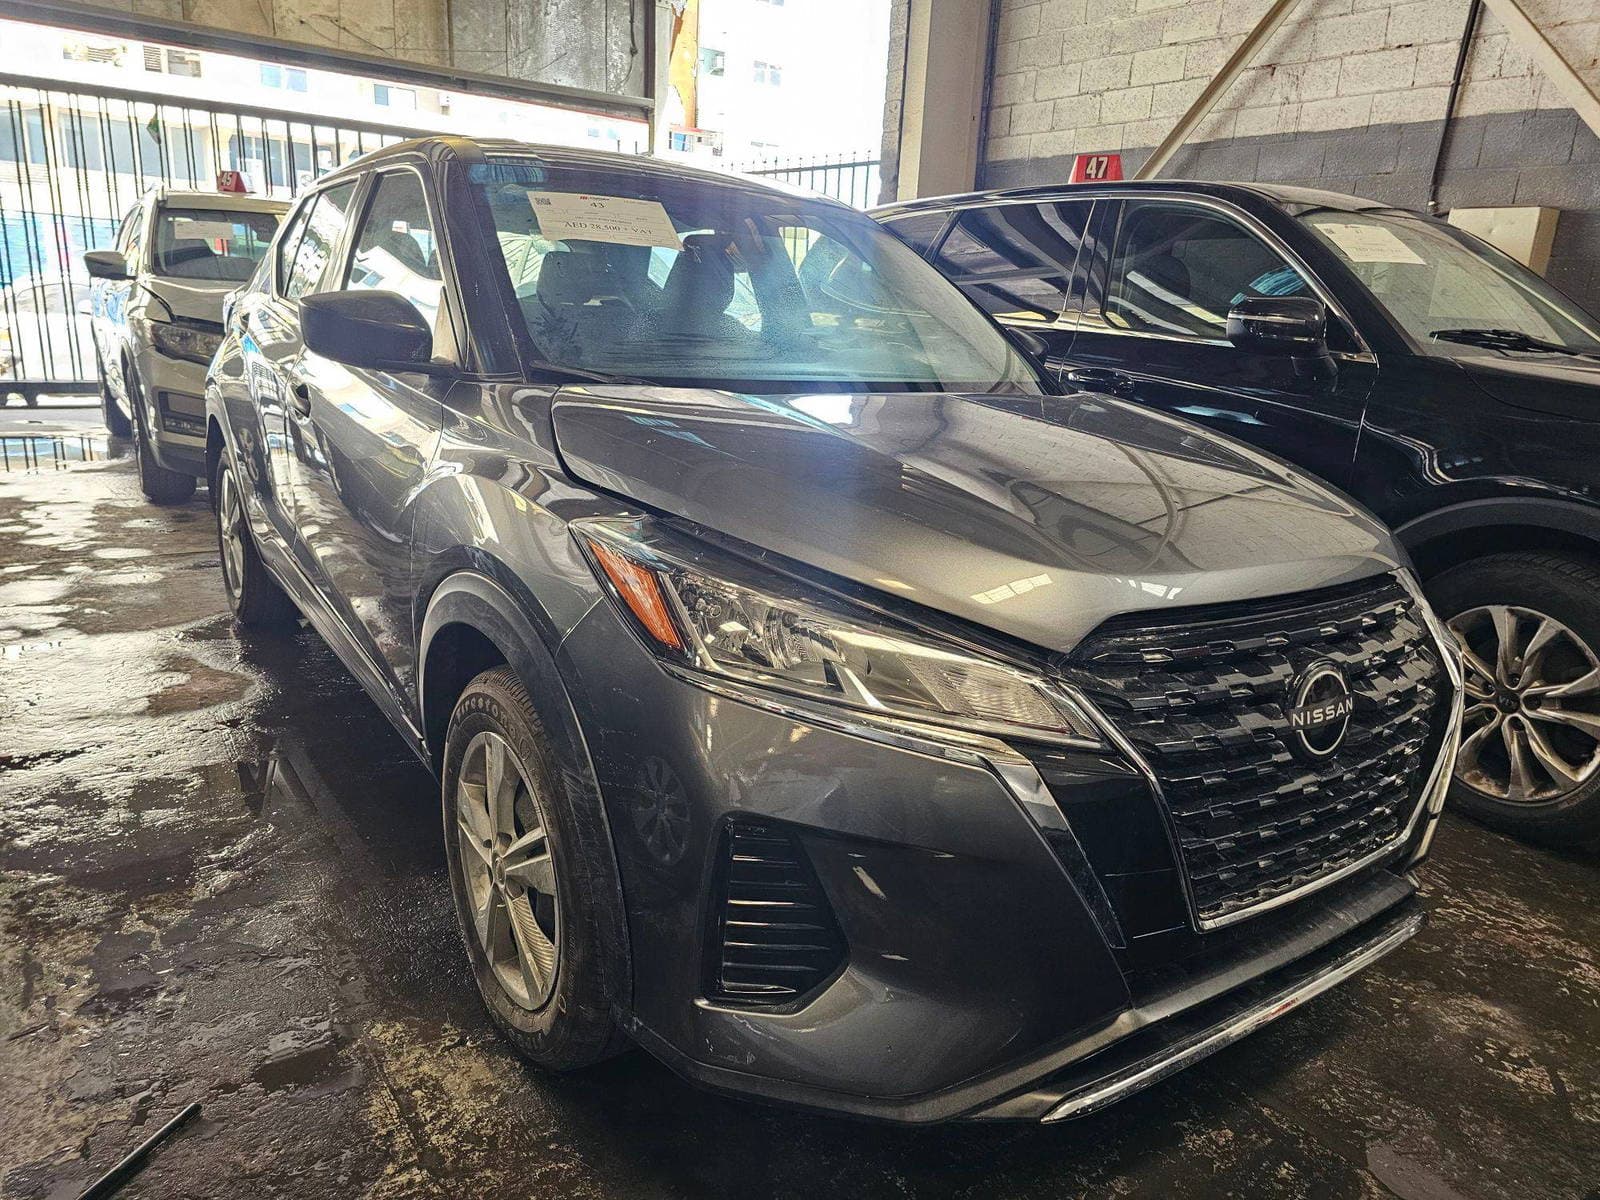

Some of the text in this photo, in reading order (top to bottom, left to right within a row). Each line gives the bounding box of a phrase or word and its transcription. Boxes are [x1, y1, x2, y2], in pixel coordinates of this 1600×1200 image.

[1086, 156, 1108, 179] 47
[221, 172, 233, 186] 45
[564, 221, 587, 229] AED
[631, 226, 653, 235] VAT
[1292, 697, 1353, 727] NISSAN
